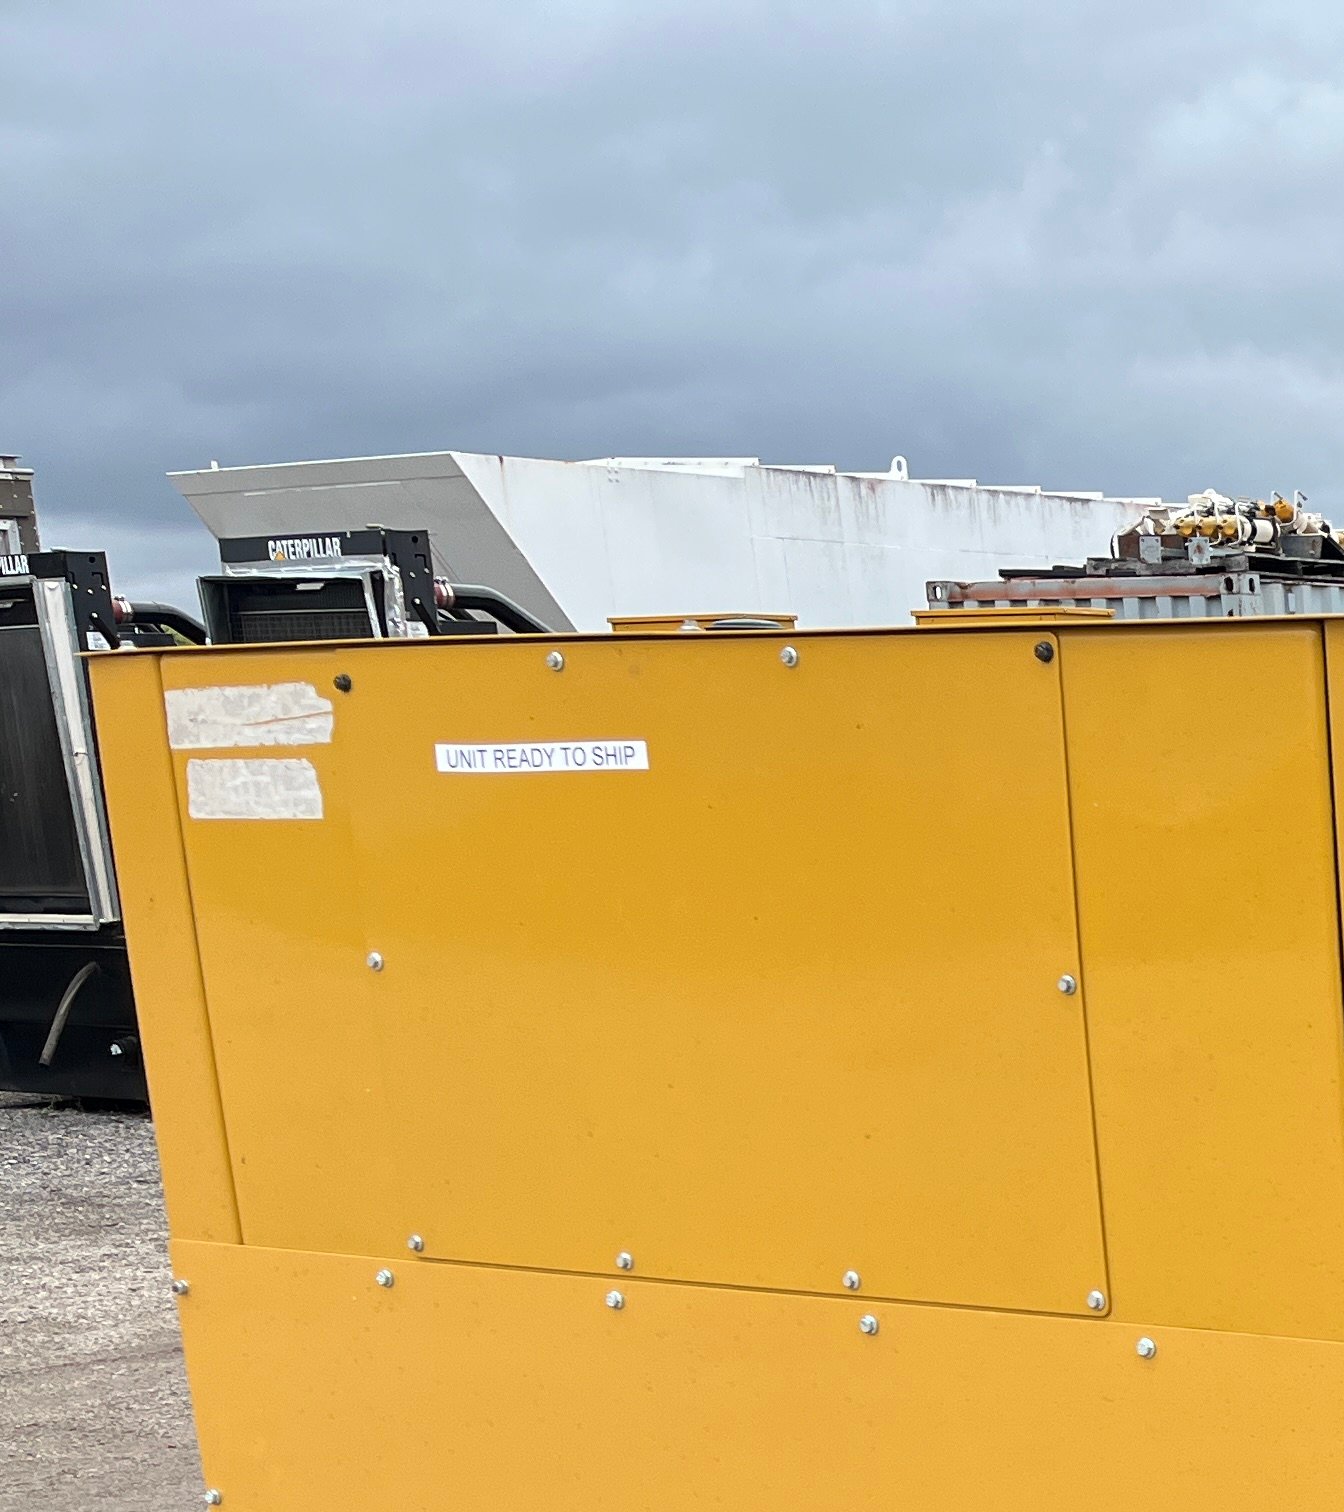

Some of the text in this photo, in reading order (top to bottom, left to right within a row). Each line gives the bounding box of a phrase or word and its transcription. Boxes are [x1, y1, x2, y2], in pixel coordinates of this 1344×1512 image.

[267, 536, 341, 561] CATERPILLAR
[446, 745, 635, 769] UNIT READY TO SHIP
